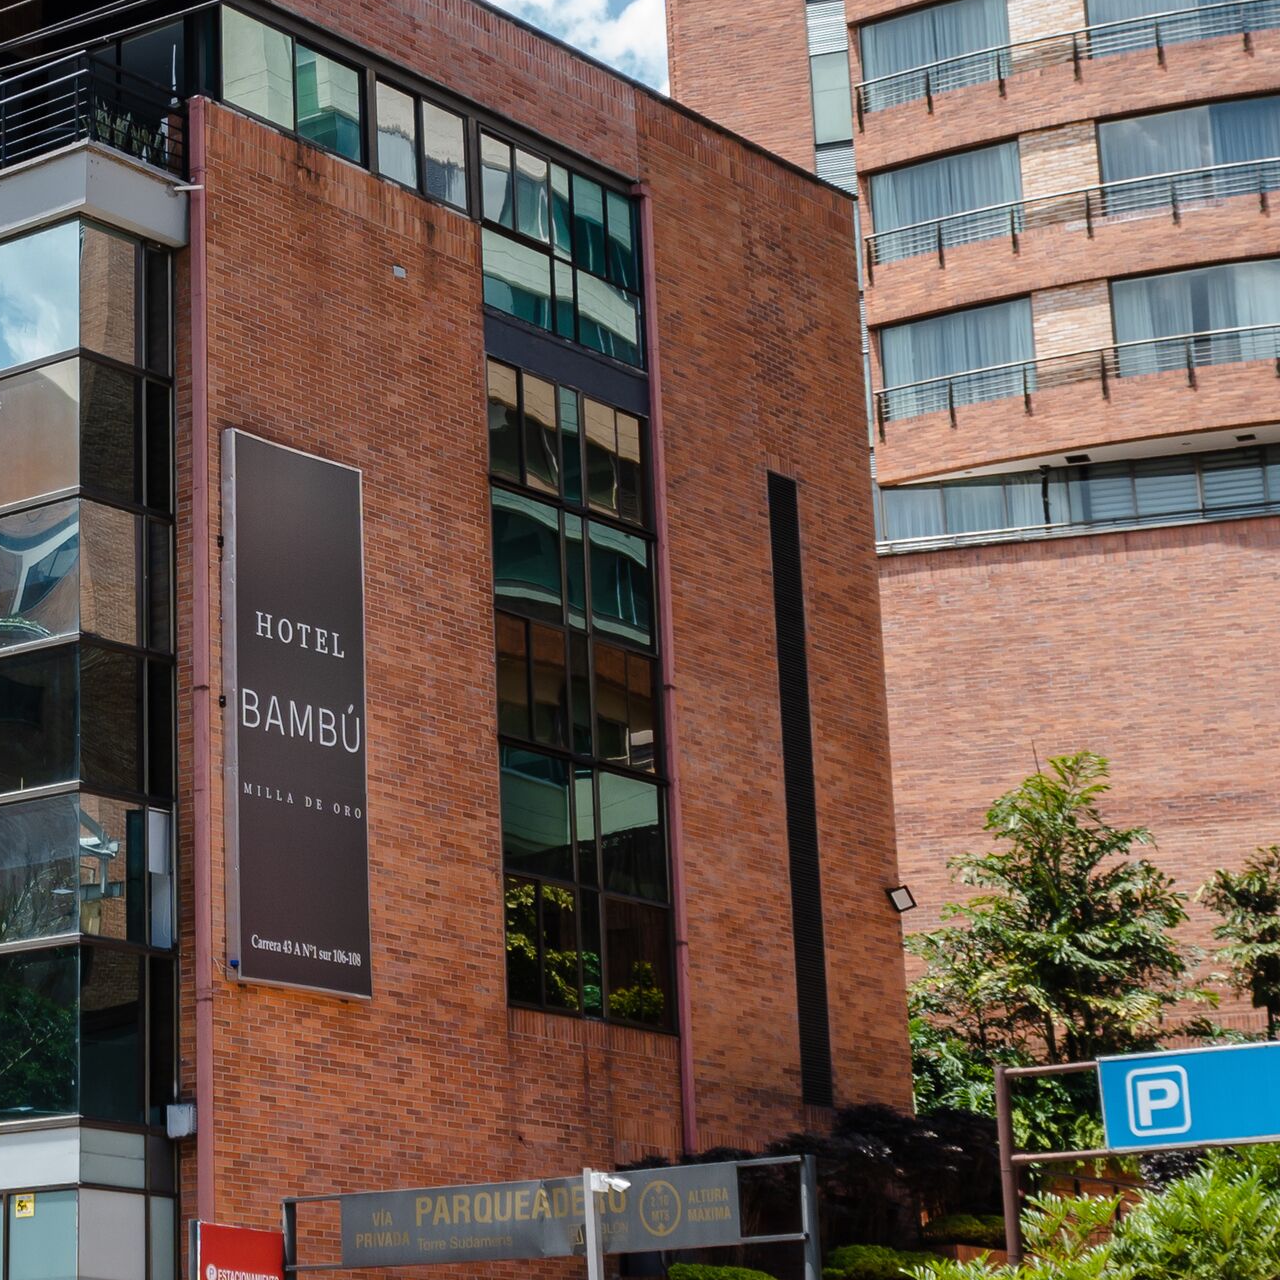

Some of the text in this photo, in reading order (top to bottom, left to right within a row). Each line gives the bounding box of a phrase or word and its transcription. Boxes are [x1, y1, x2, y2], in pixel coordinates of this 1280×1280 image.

[255, 611, 345, 658] HOTEL
[242, 688, 360, 753] BAMBÚ
[243, 782, 361, 819] MILLA DE ORO
[251, 934, 281, 953] Carrera
[282, 940, 292, 954] 43
[294, 942, 301, 956] A
[319, 949, 331, 961] sur
[333, 949, 361, 967] 106-108
[1136, 1078, 1180, 1126] P
[687, 1187, 729, 1204] ALTURA
[372, 1207, 393, 1227] VÍA
[355, 1231, 411, 1249] PRIVADA
[417, 1236, 446, 1253] Torre
